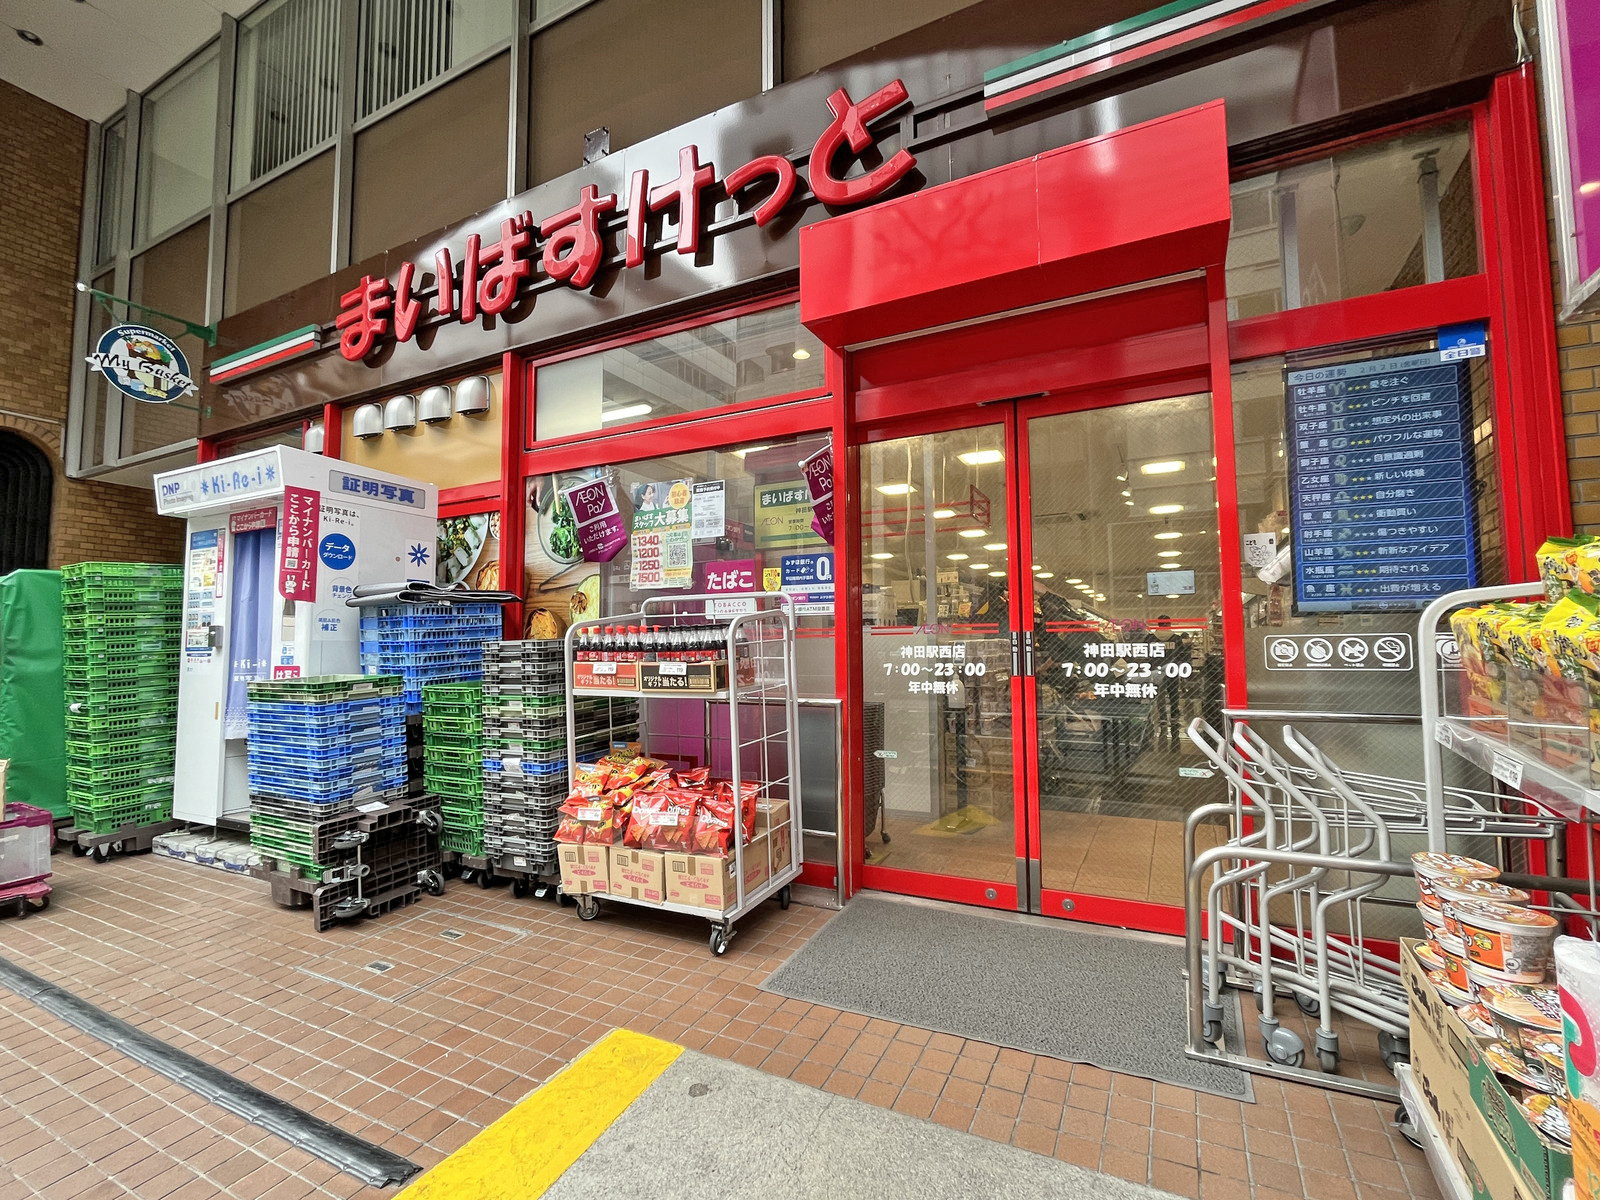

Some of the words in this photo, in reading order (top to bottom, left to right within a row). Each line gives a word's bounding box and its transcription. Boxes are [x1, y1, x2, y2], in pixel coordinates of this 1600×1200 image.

[336, 78, 917, 363] まいばすけっと
[117, 328, 176, 352] Supermarket
[93, 353, 130, 371] My
[138, 358, 192, 390] Basket
[1293, 368, 1347, 382] 今日の運勢
[1297, 385, 1327, 396] 牡羊座
[1297, 403, 1328, 414] 牡牛座
[1371, 392, 1431, 406] ピンチを回避
[1299, 421, 1328, 431] 双子座
[1372, 409, 1442, 425] 想定外の出来事
[1373, 428, 1443, 443] パワフルな運勢
[1301, 475, 1330, 485] 乙女座
[1374, 468, 1425, 480] 新しい体験
[162, 482, 180, 496] DNP
[341, 475, 415, 504] 証明写真
[1302, 493, 1331, 503] 天秤座
[1375, 488, 1416, 500] 自分磨き
[653, 507, 689, 527] 大募集
[285, 493, 300, 558] ここから申請
[589, 520, 608, 533] ご利用
[1303, 529, 1333, 538] 射手座
[1377, 525, 1439, 537] 傷つきやすい
[301, 495, 314, 591] マイナンバーカード
[325, 542, 351, 553] データ
[637, 535, 659, 547] 1340
[322, 552, 353, 561] ダウンロード
[637, 547, 660, 559] 1200
[1304, 547, 1334, 557] 山羊座
[638, 560, 660, 571] 1250
[1305, 565, 1335, 575] 水瓶座
[1379, 564, 1430, 574] 期待される
[637, 572, 660, 583] 1500
[707, 569, 754, 590] たばこ
[1380, 582, 1441, 593] 出費が増える
[321, 623, 338, 632] 補正
[900, 645, 966, 659] 神田駅西店
[1083, 642, 1166, 658] 神田駅西店
[908, 680, 959, 695] 年中無休
[1094, 682, 1158, 699] 年中無休
